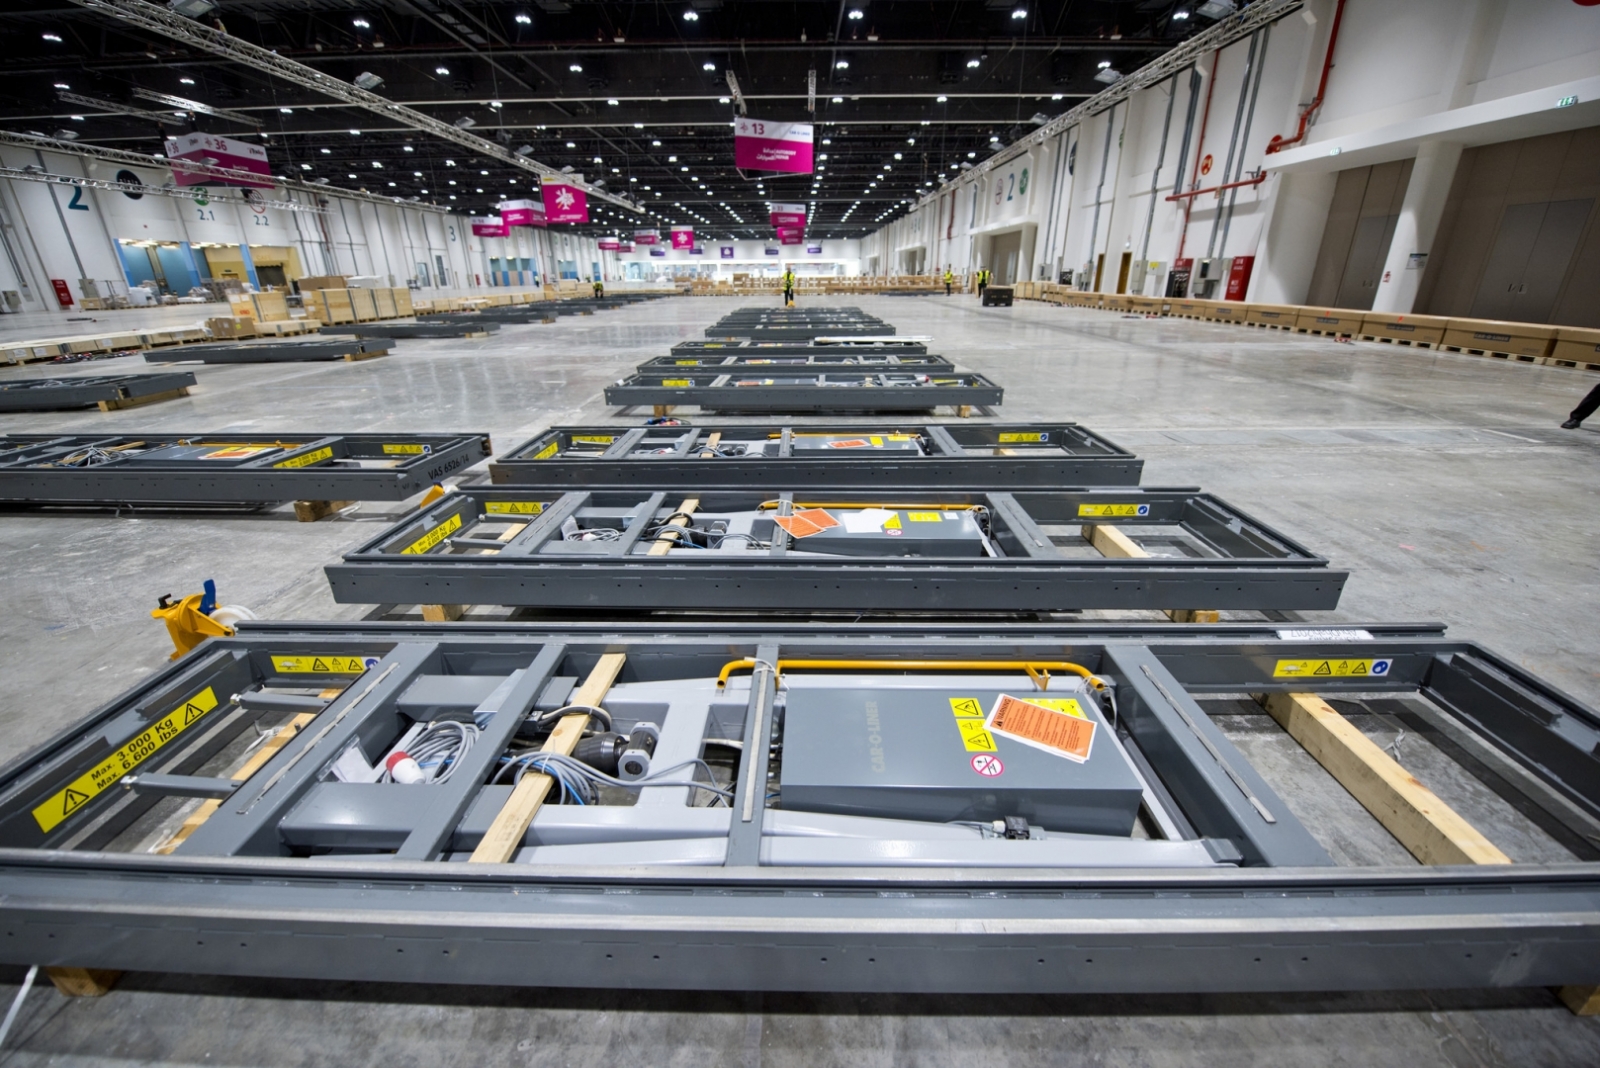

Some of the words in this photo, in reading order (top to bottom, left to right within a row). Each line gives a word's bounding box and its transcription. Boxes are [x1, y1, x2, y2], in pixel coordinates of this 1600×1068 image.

[751, 123, 765, 135] 13
[170, 141, 180, 154] 36
[213, 138, 228, 152] 36
[61, 177, 90, 211] 2
[1007, 173, 1016, 201] 2
[197, 209, 216, 222] 2.1
[253, 215, 270, 227] 2.2
[448, 225, 456, 242] 3
[428, 466, 443, 480] VAS
[996, 698, 1012, 720] WARNING
[864, 700, 886, 773] CAR-O-LINER
[91, 763, 116, 781] Max.
[116, 732, 151, 762] 3.000
[154, 718, 174, 734] Kg
[96, 771, 121, 790] Max.
[121, 741, 156, 770] 6.600
[158, 726, 179, 743] lbs
